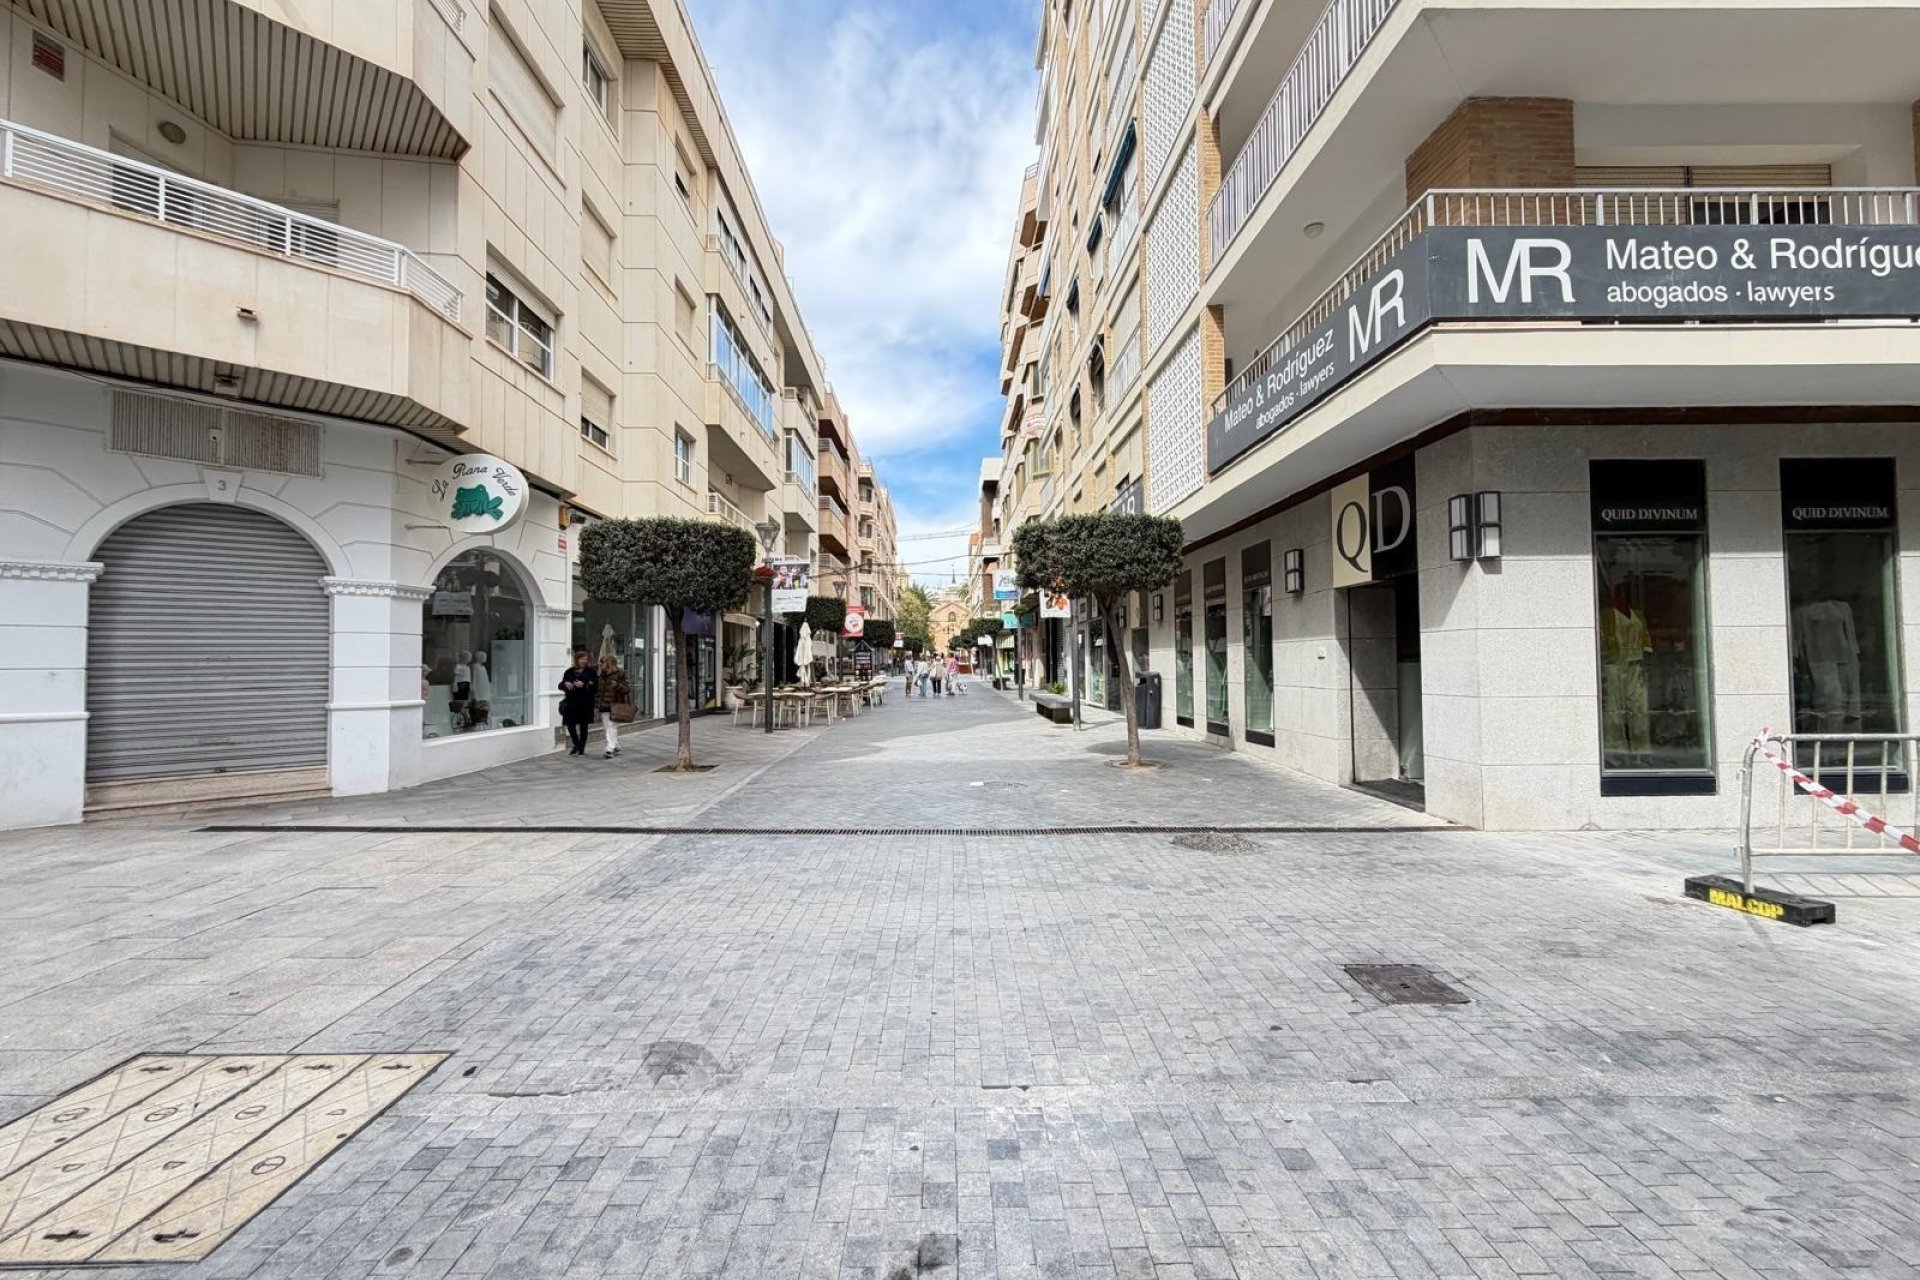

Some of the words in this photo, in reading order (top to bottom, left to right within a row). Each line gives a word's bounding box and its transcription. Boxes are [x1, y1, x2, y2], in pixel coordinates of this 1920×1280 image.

[1466, 238, 1576, 304] MR
[1606, 238, 1718, 271] Mateo
[1730, 238, 1757, 270] &
[1770, 236, 1920, 277] Rodrígu
[1606, 281, 1728, 309] abogados
[1746, 280, 1836, 308] lawyers
[1224, 398, 1254, 434] Mateo
[1255, 384, 1265, 408] &
[1266, 328, 1335, 399] Rodríguez
[1348, 268, 1406, 363] MR
[1255, 391, 1295, 430] abogados
[1299, 361, 1335, 398] lawyers
[216, 478, 228, 492] 3
[452, 462, 488, 480] Rana
[491, 466, 520, 497] Verde
[1601, 507, 1636, 522] QUID
[1637, 507, 1698, 521] DIVINUM
[1791, 506, 1827, 521] QUID
[1828, 506, 1890, 520] DIVINUM
